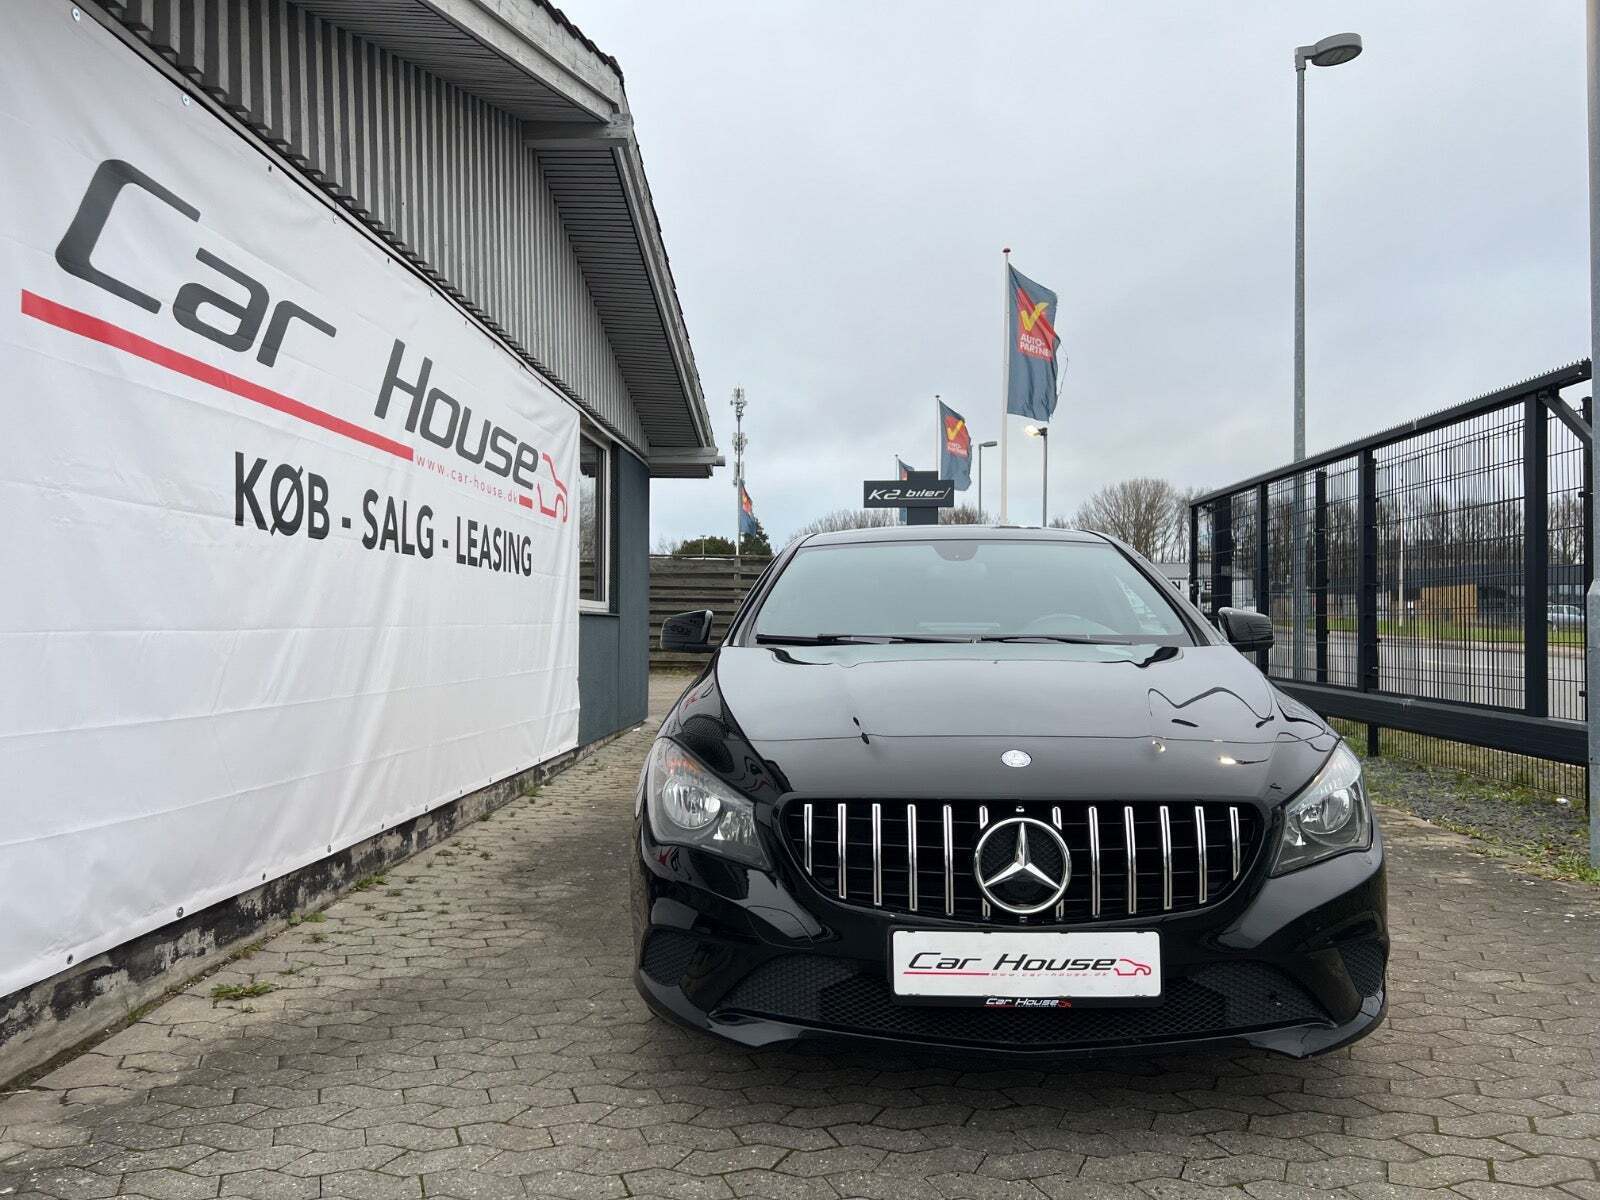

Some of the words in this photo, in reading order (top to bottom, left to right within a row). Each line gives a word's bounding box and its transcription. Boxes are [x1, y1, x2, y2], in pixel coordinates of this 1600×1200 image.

[55, 159, 337, 368] Car
[374, 338, 538, 490] House
[416, 455, 518, 504] www.car-house.dk
[868, 489, 901, 500] K2
[235, 451, 330, 540] KØB
[362, 488, 434, 560] SALG
[456, 515, 532, 577] LEASING
[908, 952, 982, 970] Car
[993, 953, 1117, 971] House
[985, 997, 1012, 1005] Car
[1015, 998, 1059, 1007] House
